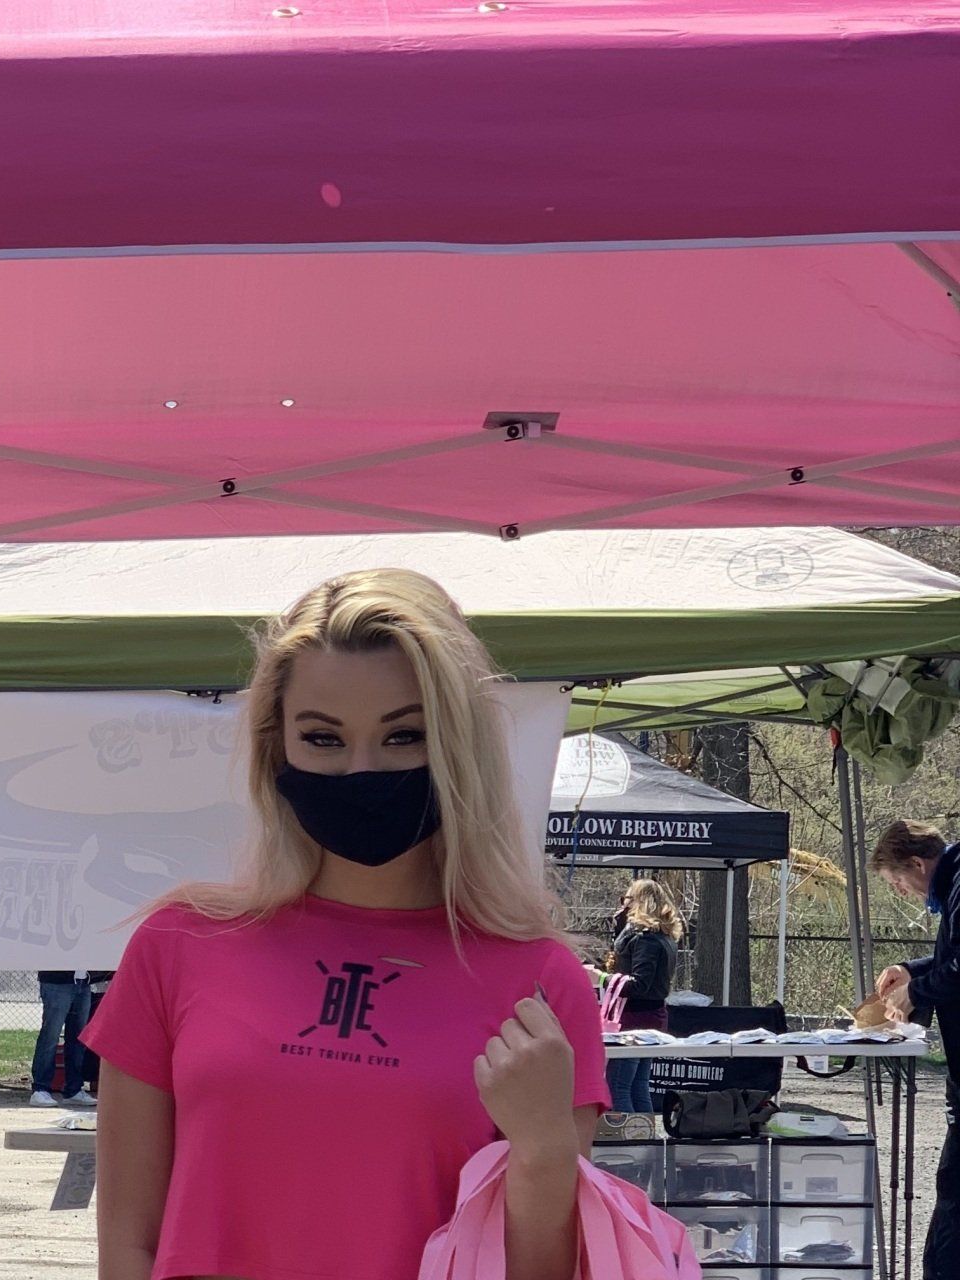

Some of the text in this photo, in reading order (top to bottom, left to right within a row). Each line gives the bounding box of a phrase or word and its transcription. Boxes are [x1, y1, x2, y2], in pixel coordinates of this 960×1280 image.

[620, 819, 713, 839] BREWERY
[580, 839, 638, 848] CONNECTICUT
[319, 962, 380, 1038] BTE
[281, 1043, 400, 1067] BEST TRIVIA EVER
[671, 1064, 685, 1078] AND
[687, 1065, 724, 1081] GROWLERS
